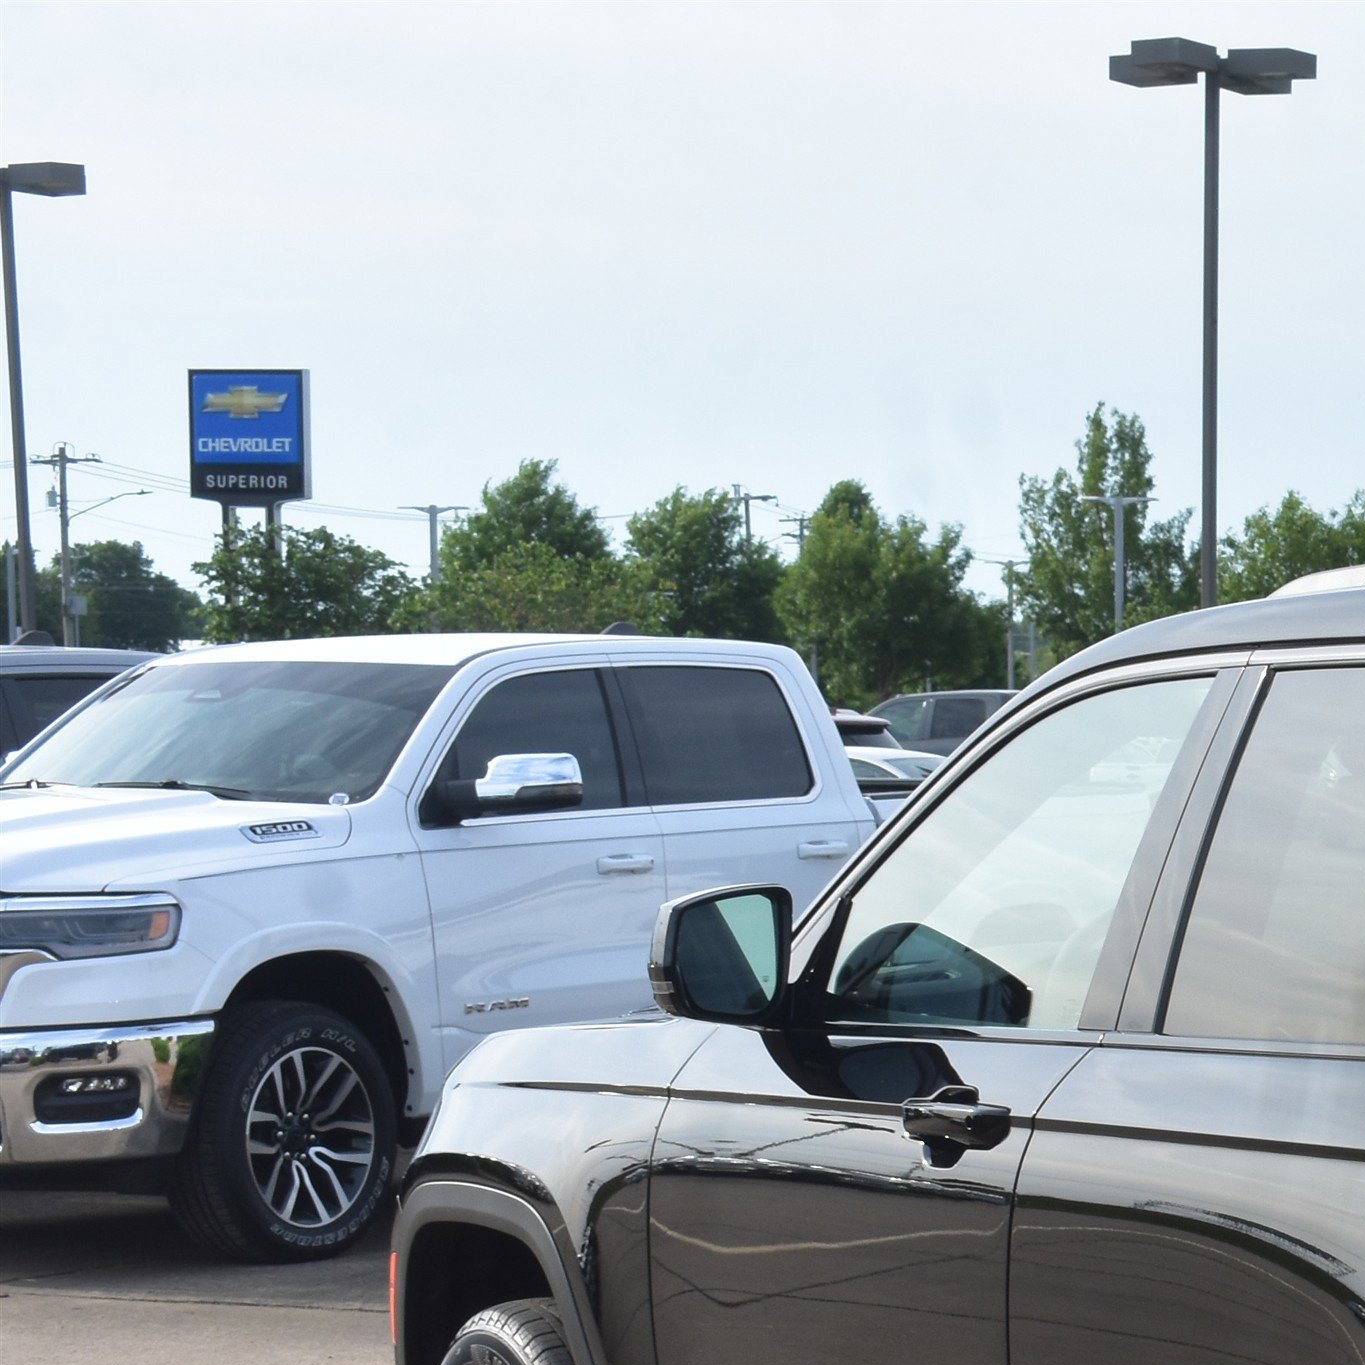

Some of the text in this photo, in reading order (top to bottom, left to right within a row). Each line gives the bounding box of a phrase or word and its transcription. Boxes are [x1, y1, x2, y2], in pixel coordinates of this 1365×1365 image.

[198, 437, 292, 453] CHEVROLET
[206, 474, 289, 489] SUPERIOR
[252, 822, 308, 835] 1500
